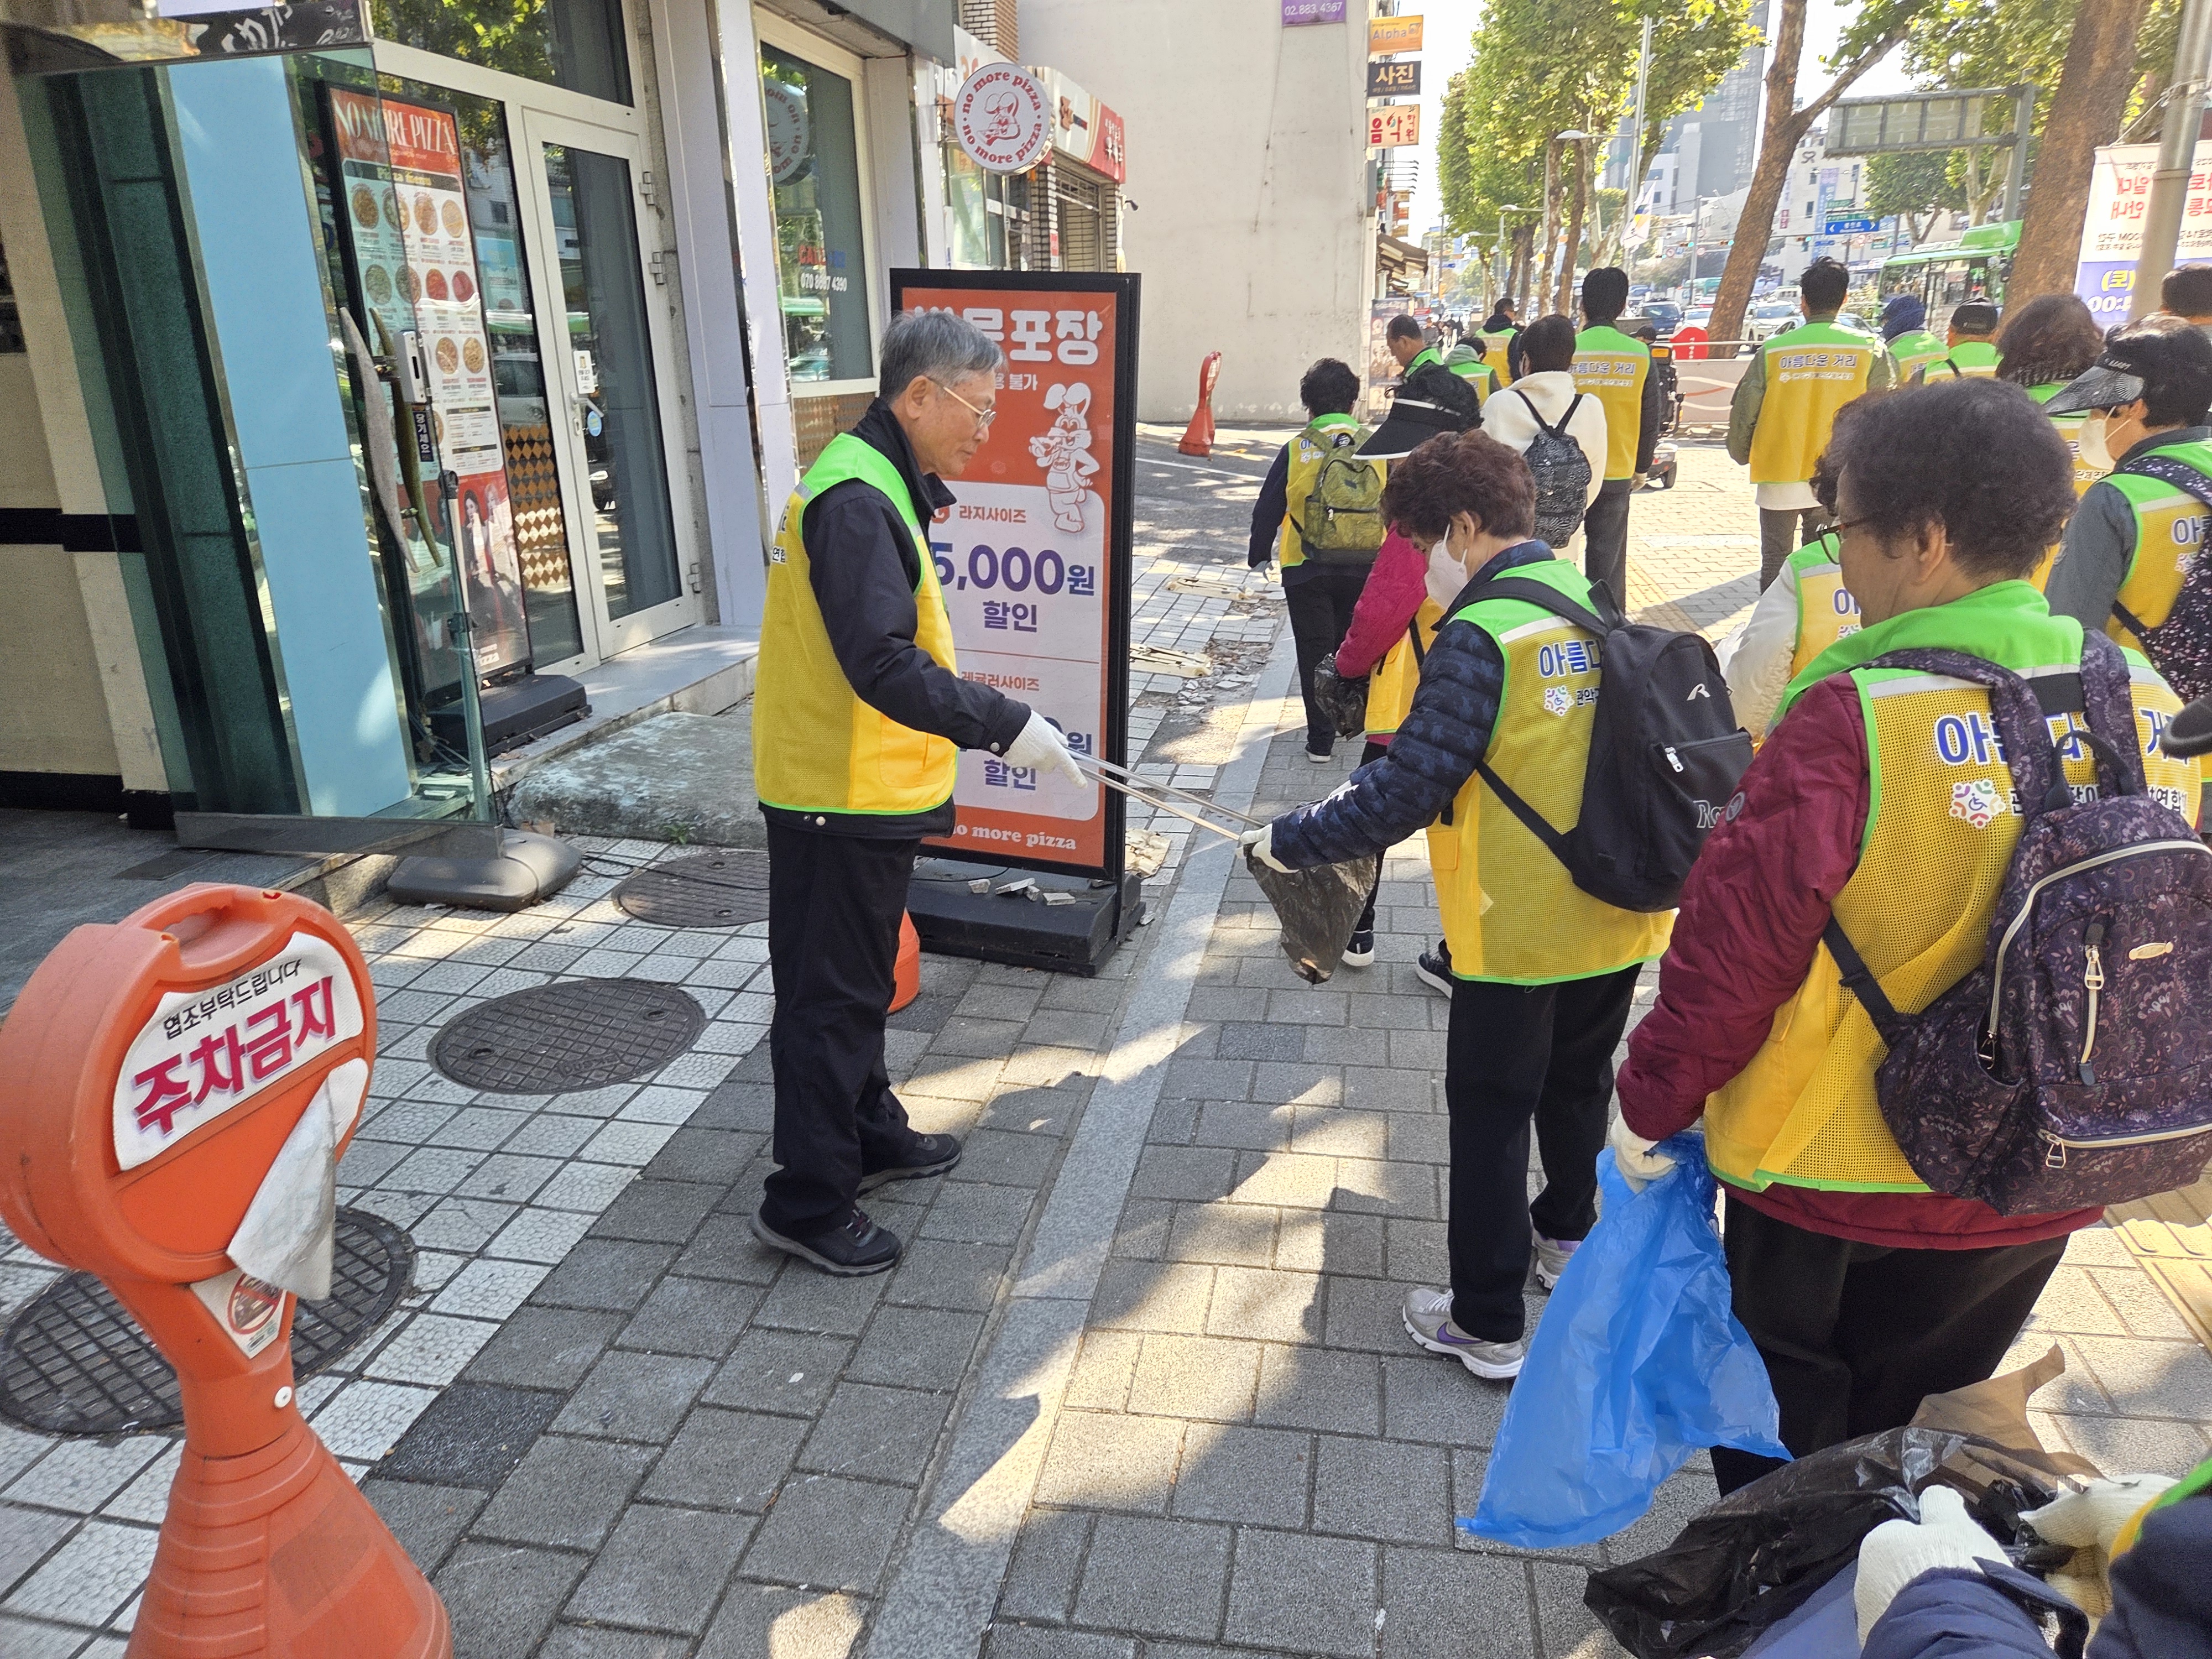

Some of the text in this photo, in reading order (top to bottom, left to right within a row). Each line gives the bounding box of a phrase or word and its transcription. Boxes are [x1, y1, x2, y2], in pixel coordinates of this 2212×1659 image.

[1372, 27, 1407, 40] Alpha
[1375, 64, 1413, 85] 사진
[962, 72, 1041, 114] no more pizza
[409, 113, 456, 155] PIZZA
[962, 124, 975, 145] no
[974, 145, 1013, 164] more
[1015, 123, 1042, 161] pizza
[1613, 362, 1636, 375] 거리
[1780, 353, 1857, 369] 아름다운 거리
[1009, 373, 1039, 391] 불가
[958, 505, 1027, 524] 라지사이즈
[982, 601, 1038, 633] 할인
[983, 759, 1037, 791] 할인
[971, 825, 1022, 843] more
[1025, 831, 1077, 851] pizza
[134, 975, 336, 1135] 주차금지
